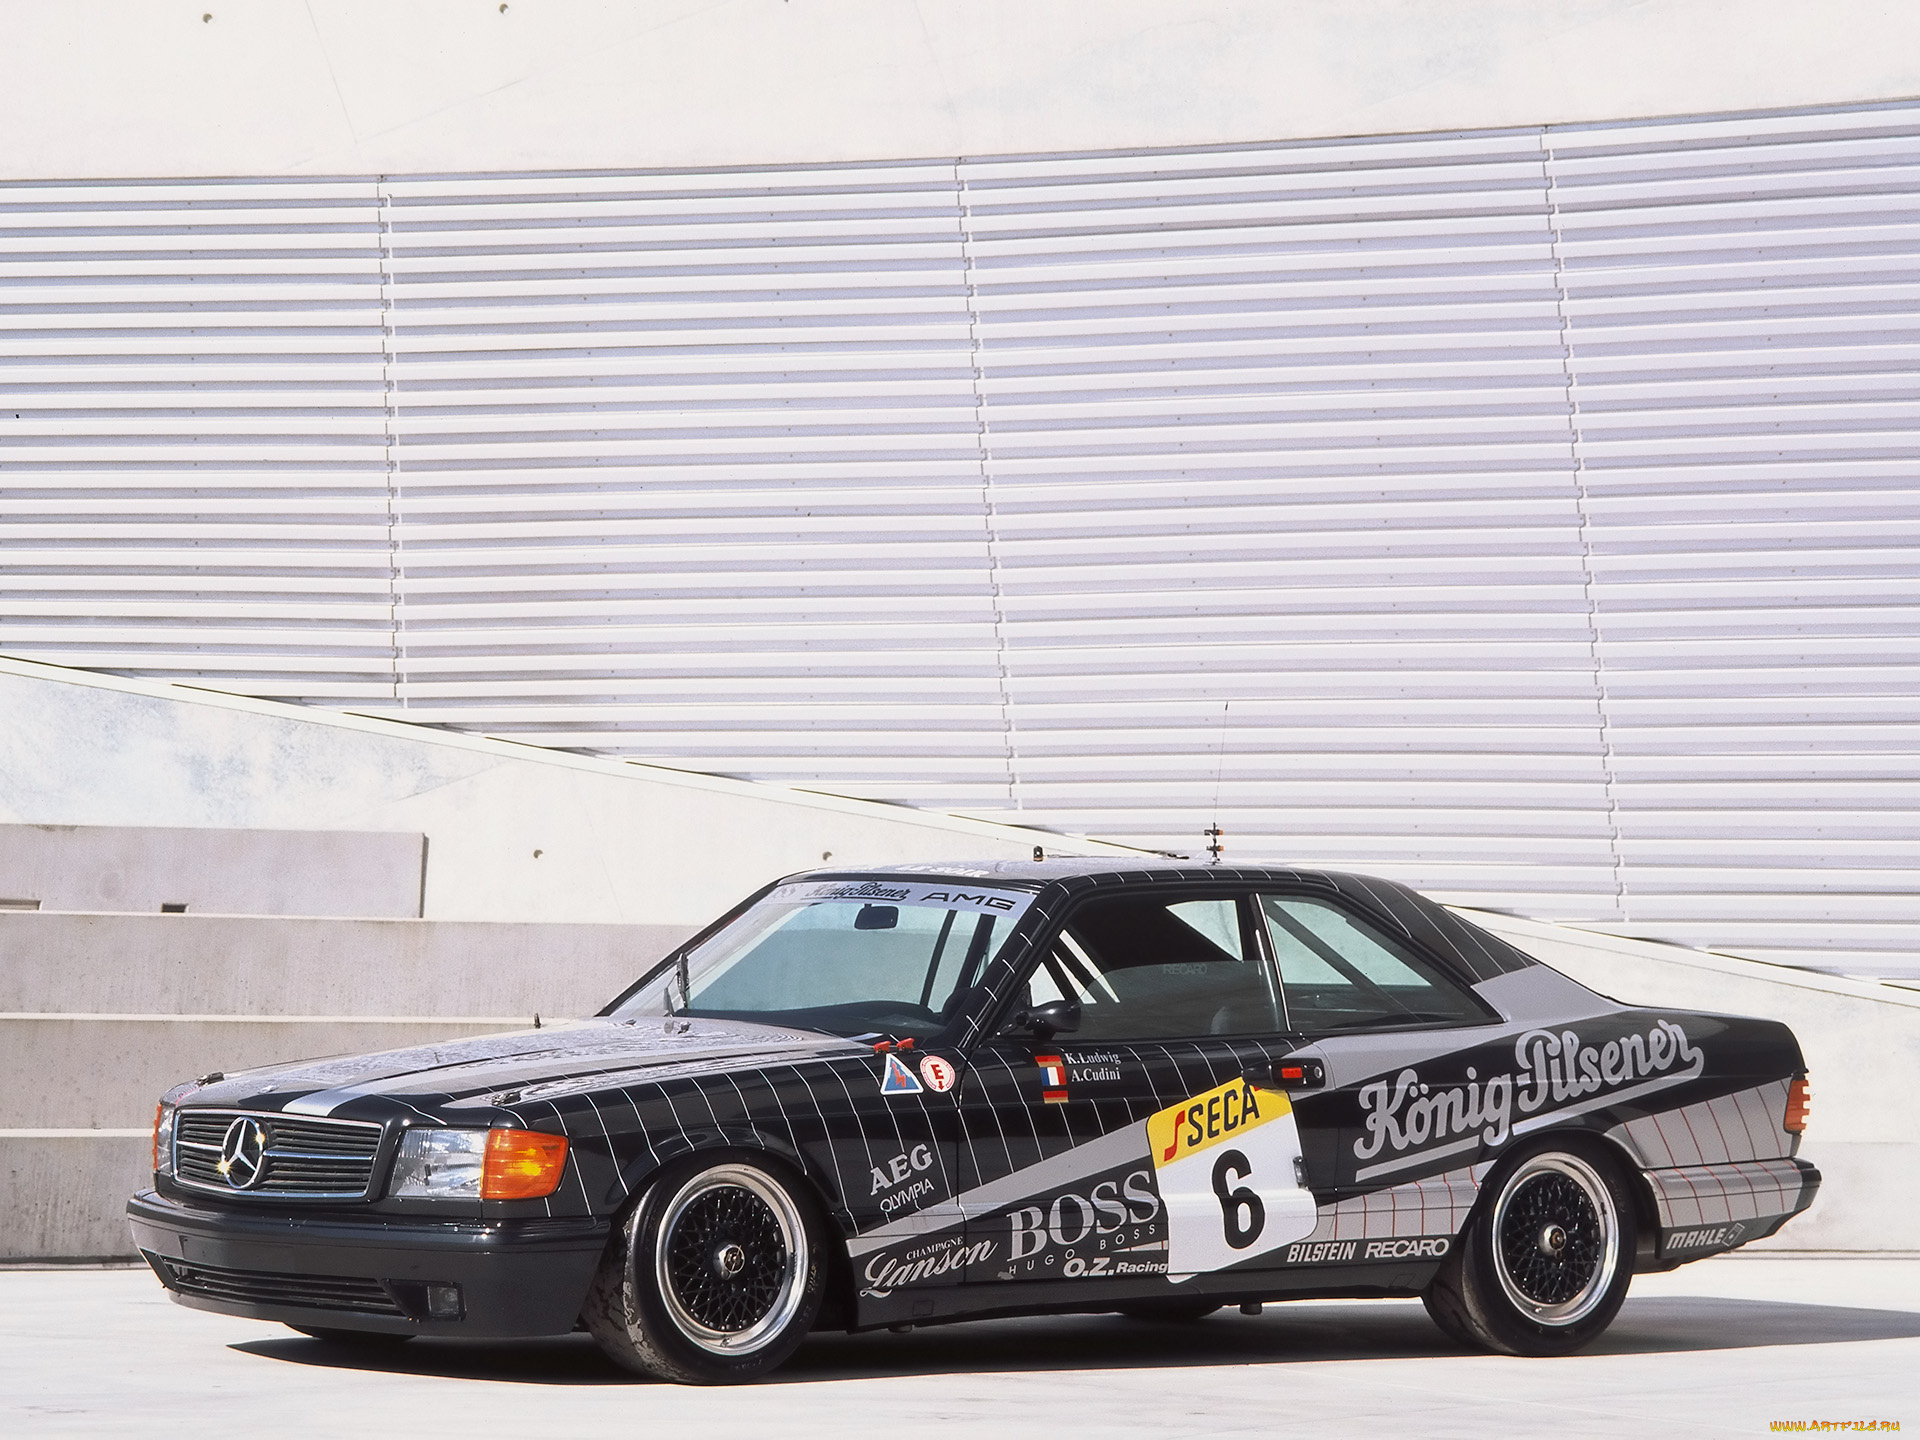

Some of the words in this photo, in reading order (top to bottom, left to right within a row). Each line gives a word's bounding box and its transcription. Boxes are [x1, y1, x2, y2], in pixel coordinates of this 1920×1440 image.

[920, 892, 1016, 911] AMG
[1163, 963, 1207, 975] RECARO
[1065, 1051, 1121, 1065] K.Ludwig
[930, 1063, 945, 1080] E
[1072, 1067, 1121, 1082] A.Cudini
[1353, 1019, 1704, 1160] König-Pilsener
[1187, 1082, 1260, 1148] SECA
[870, 1143, 933, 1196] AEG
[880, 1178, 935, 1212] OLYMPIA
[1211, 1148, 1266, 1250] 6
[1006, 1170, 1160, 1262] BOSS
[906, 1235, 964, 1260] CHAMPAGNE
[1009, 1248, 1076, 1275] HUGO
[1100, 1223, 1156, 1250] BOSS
[1364, 1238, 1450, 1259] RECARO
[1666, 1228, 1727, 1250] MAHLE
[1287, 1241, 1357, 1263] BILSTEIN
[860, 1239, 998, 1298] Lanson
[1063, 1257, 1115, 1278] O.Z.
[1116, 1260, 1169, 1274] Racing
